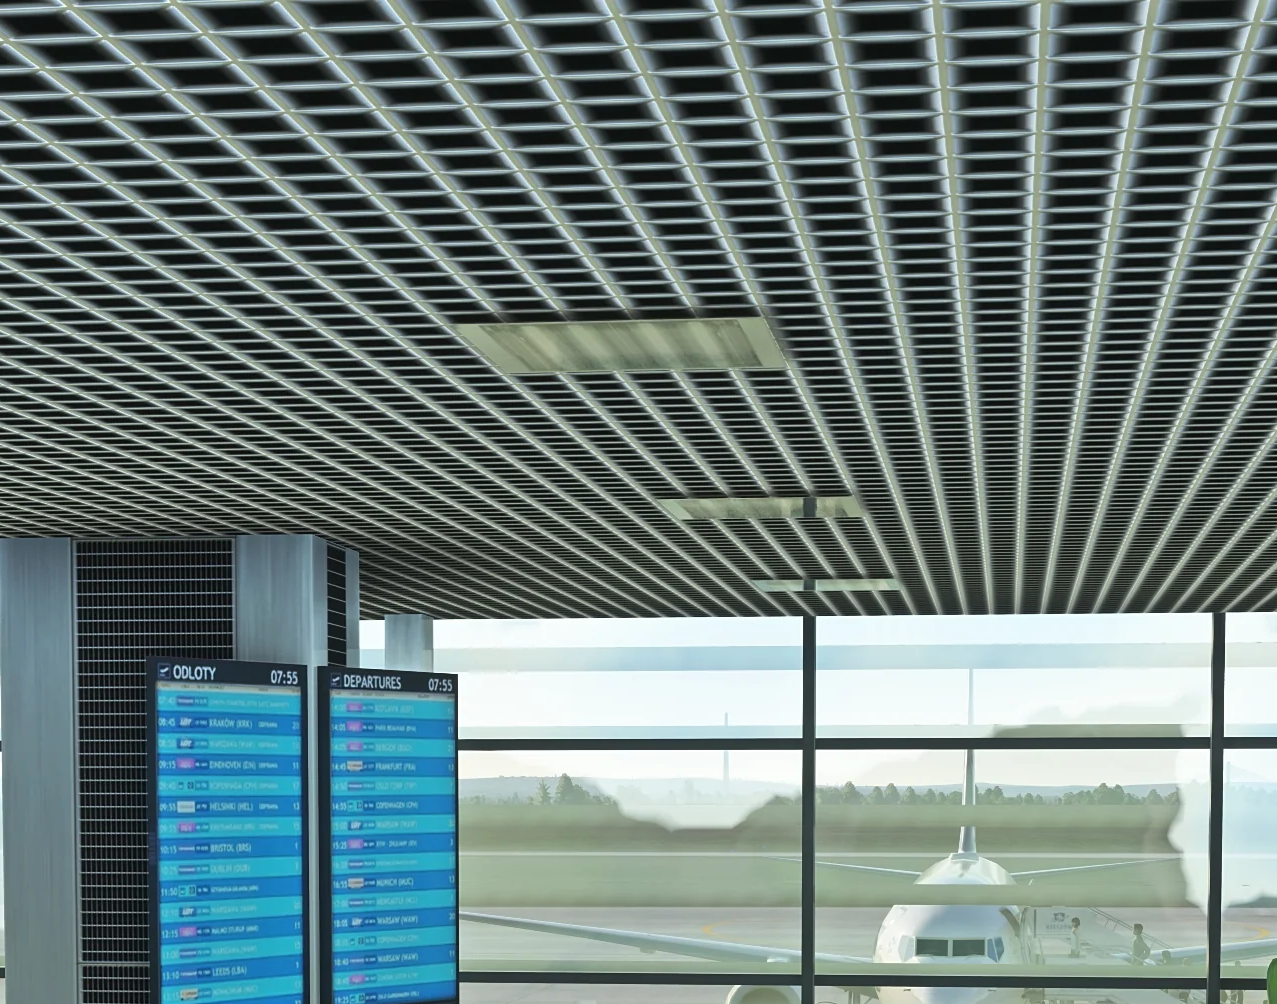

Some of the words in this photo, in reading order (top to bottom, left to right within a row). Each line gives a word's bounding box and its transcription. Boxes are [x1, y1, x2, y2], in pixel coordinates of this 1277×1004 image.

[173, 665, 216, 680] ODLOTY
[271, 670, 298, 684] 07:55
[344, 675, 401, 689] DEPARTURES
[428, 679, 452, 691] 07:55
[209, 718, 234, 727] KRAKÓW
[236, 719, 252, 729] (KRK)
[159, 761, 175, 769] 09:15
[210, 761, 241, 769] EINDHOVEN
[376, 762, 402, 770] FRANKFURT
[210, 803, 236, 811] HELSINKI
[237, 803, 253, 811] (HEL)
[161, 846, 177, 854] 10:15
[211, 844, 234, 853] BRISTOL
[236, 843, 251, 853] (BRS)
[161, 888, 178, 896] 11:50
[162, 929, 179, 938] 12:15
[163, 971, 179, 980] 13:10
[212, 968, 230, 977] LEEDS
[232, 966, 247, 976] (LBA)
